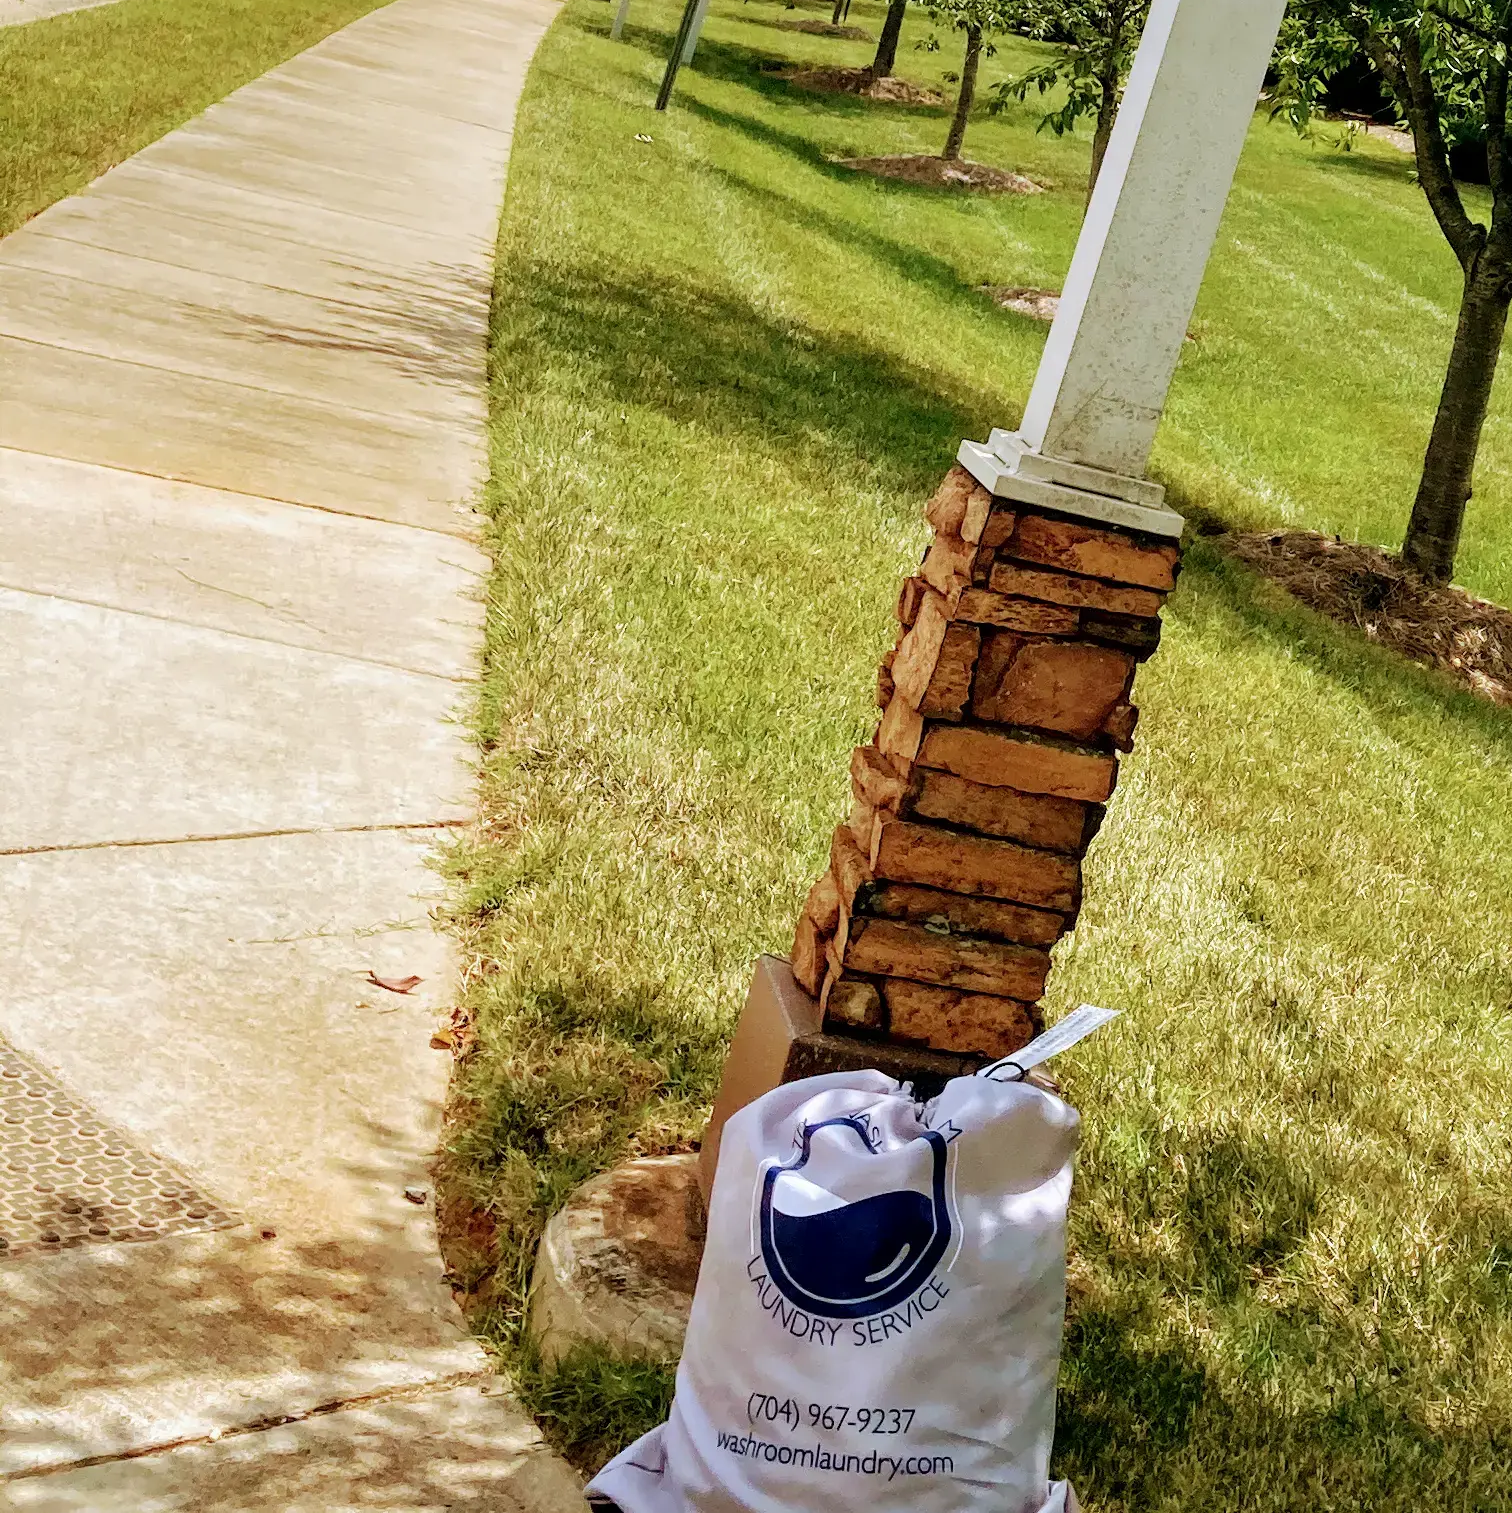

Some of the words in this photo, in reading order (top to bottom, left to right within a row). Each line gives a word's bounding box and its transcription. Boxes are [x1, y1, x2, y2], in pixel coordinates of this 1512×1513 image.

[746, 1255, 843, 1347] LAUNDRY
[852, 1274, 950, 1347] SERVICE
[747, 1392, 800, 1432] (704)
[808, 1403, 916, 1434] 967-9237
[716, 1430, 954, 1482] washroomlaundry.com
